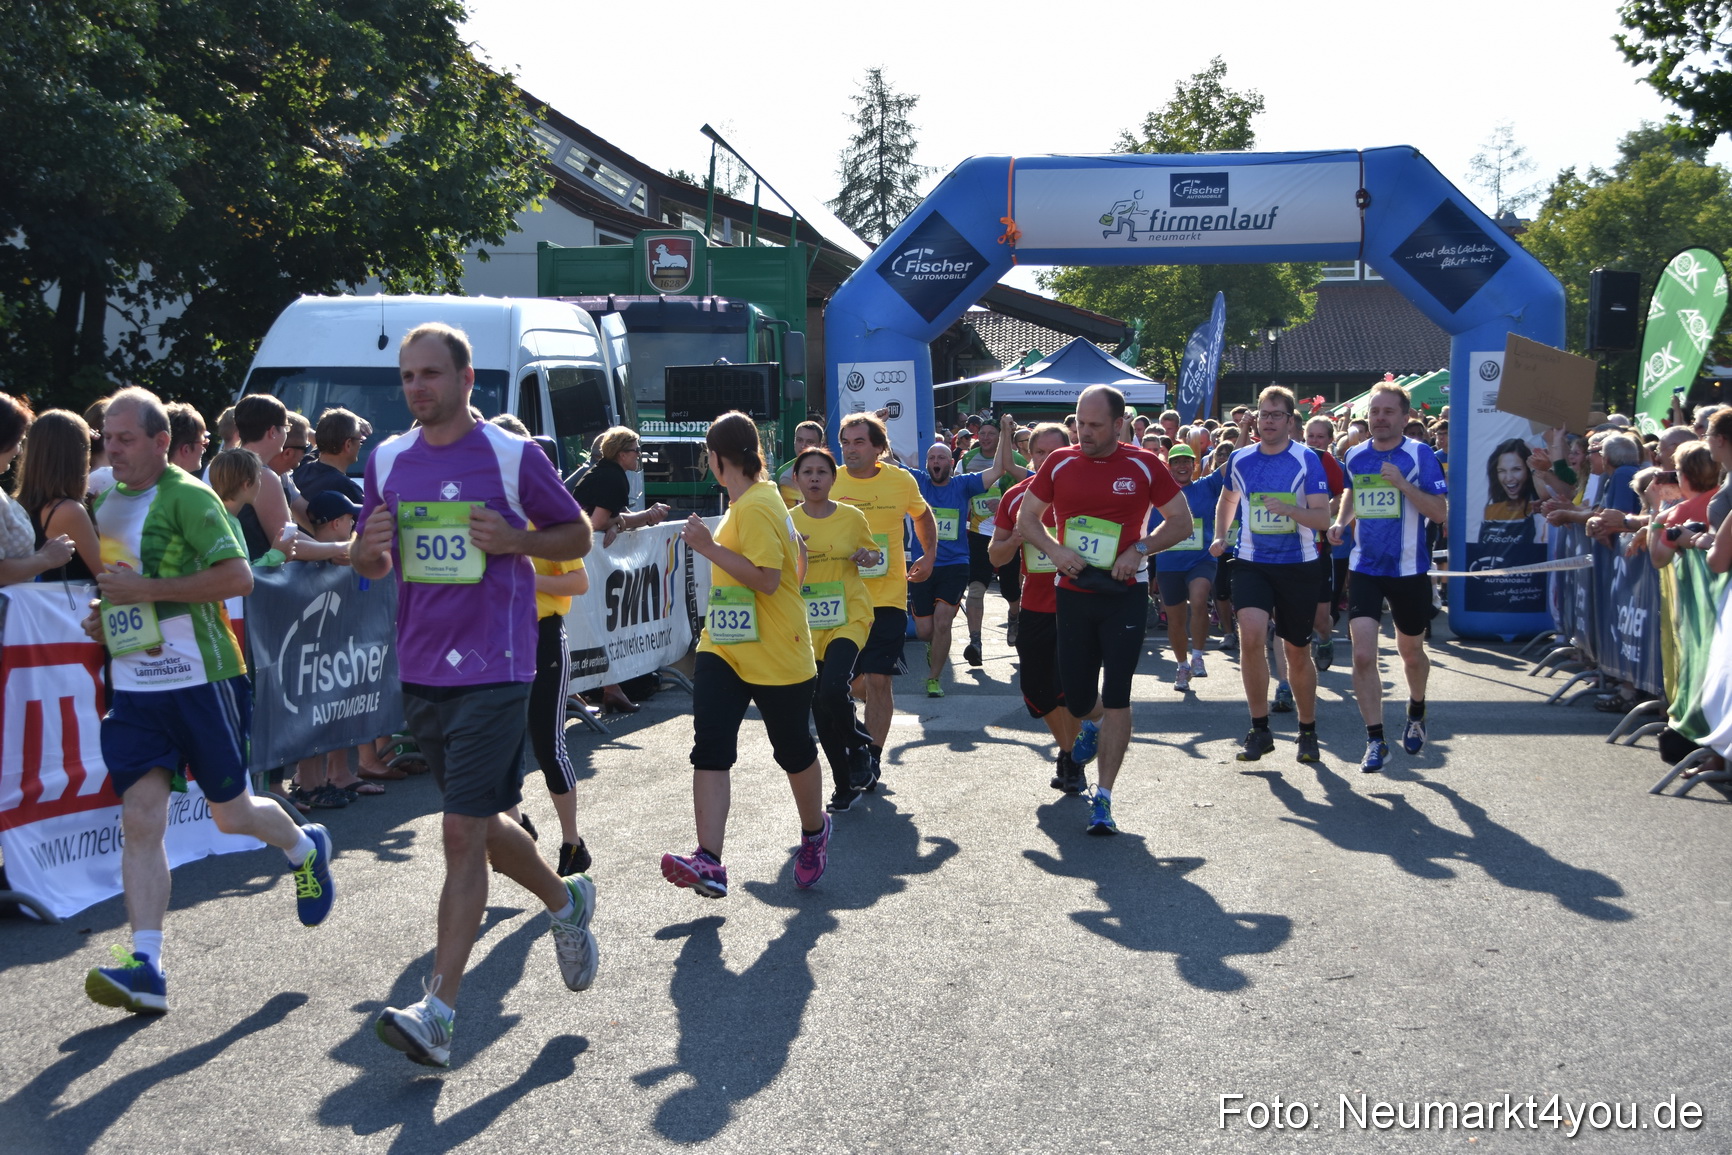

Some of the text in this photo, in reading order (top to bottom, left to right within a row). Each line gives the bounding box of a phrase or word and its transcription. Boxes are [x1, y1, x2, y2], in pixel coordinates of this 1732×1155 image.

[1182, 185, 1225, 195] Fischer
[1150, 206, 1279, 232] firmenlauf
[1148, 232, 1202, 241] neumarkt
[1415, 248, 1435, 259] und
[1437, 245, 1456, 255] das
[1470, 254, 1493, 263] mit!
[905, 259, 973, 273] Fischer
[660, 279, 680, 288] 1628
[911, 273, 967, 281] AUTOMOBILE
[1679, 309, 1714, 351] AOK
[1642, 340, 1681, 392] AOK
[887, 405, 899, 415] FIAT
[1358, 491, 1396, 506] 1123
[415, 535, 467, 561] 503
[1078, 535, 1099, 554] 31
[605, 562, 660, 632] swn
[809, 600, 841, 617] 337
[109, 606, 144, 637] 996
[709, 609, 751, 630] 1332
[134, 663, 191, 677] Lammsbräu
[298, 636, 389, 695] Fischer
[312, 691, 380, 727] AUTOMOBILE
